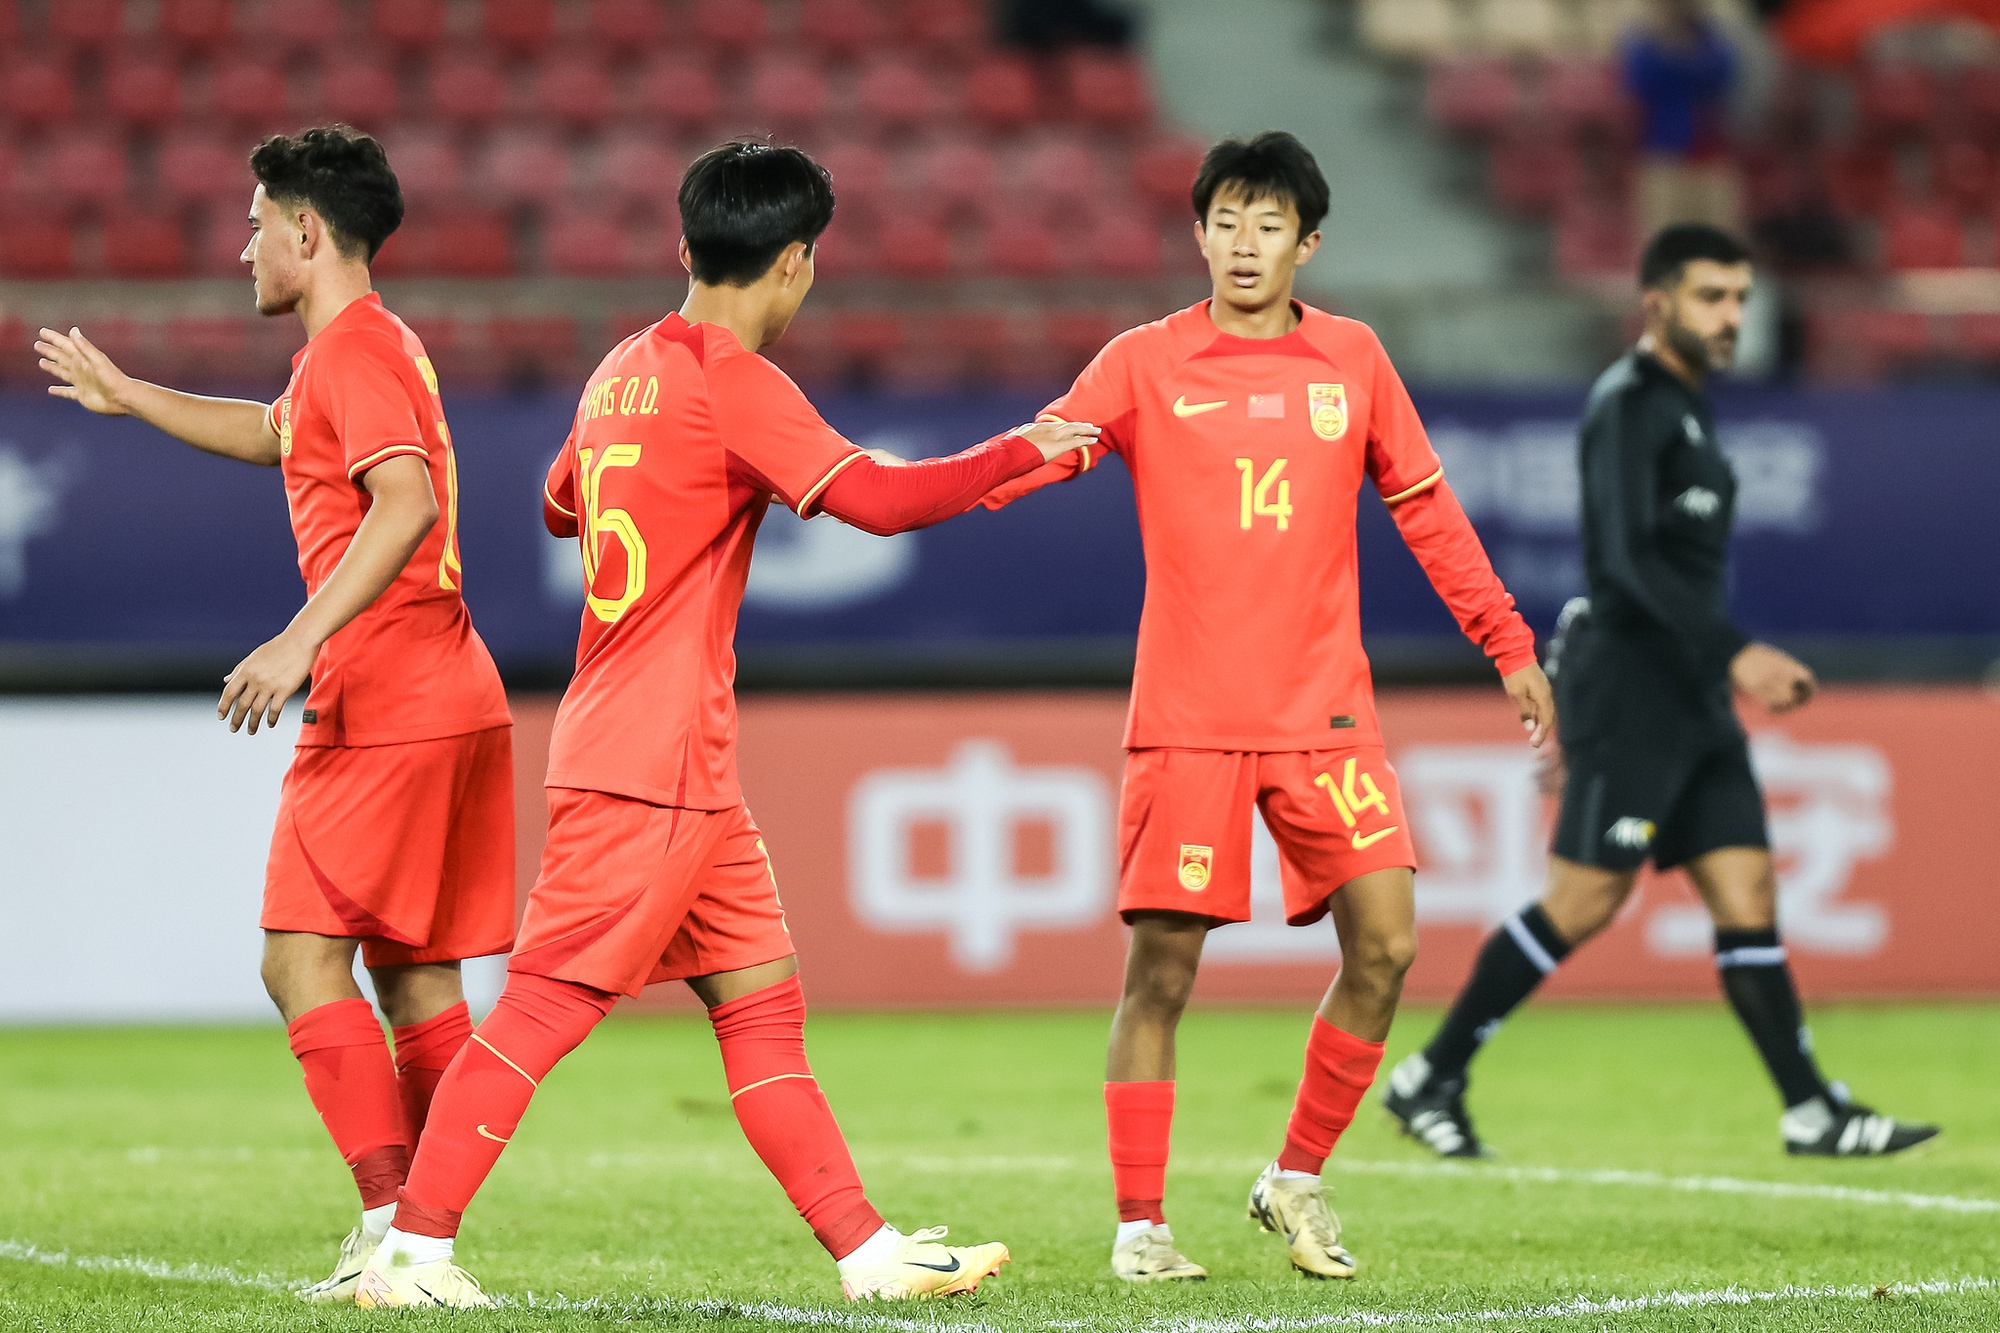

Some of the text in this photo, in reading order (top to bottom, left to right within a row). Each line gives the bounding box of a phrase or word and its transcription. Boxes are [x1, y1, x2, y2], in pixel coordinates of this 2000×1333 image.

[619, 376, 659, 416] Q.D.
[1235, 457, 1292, 531] 14
[1314, 757, 1390, 828] 14
